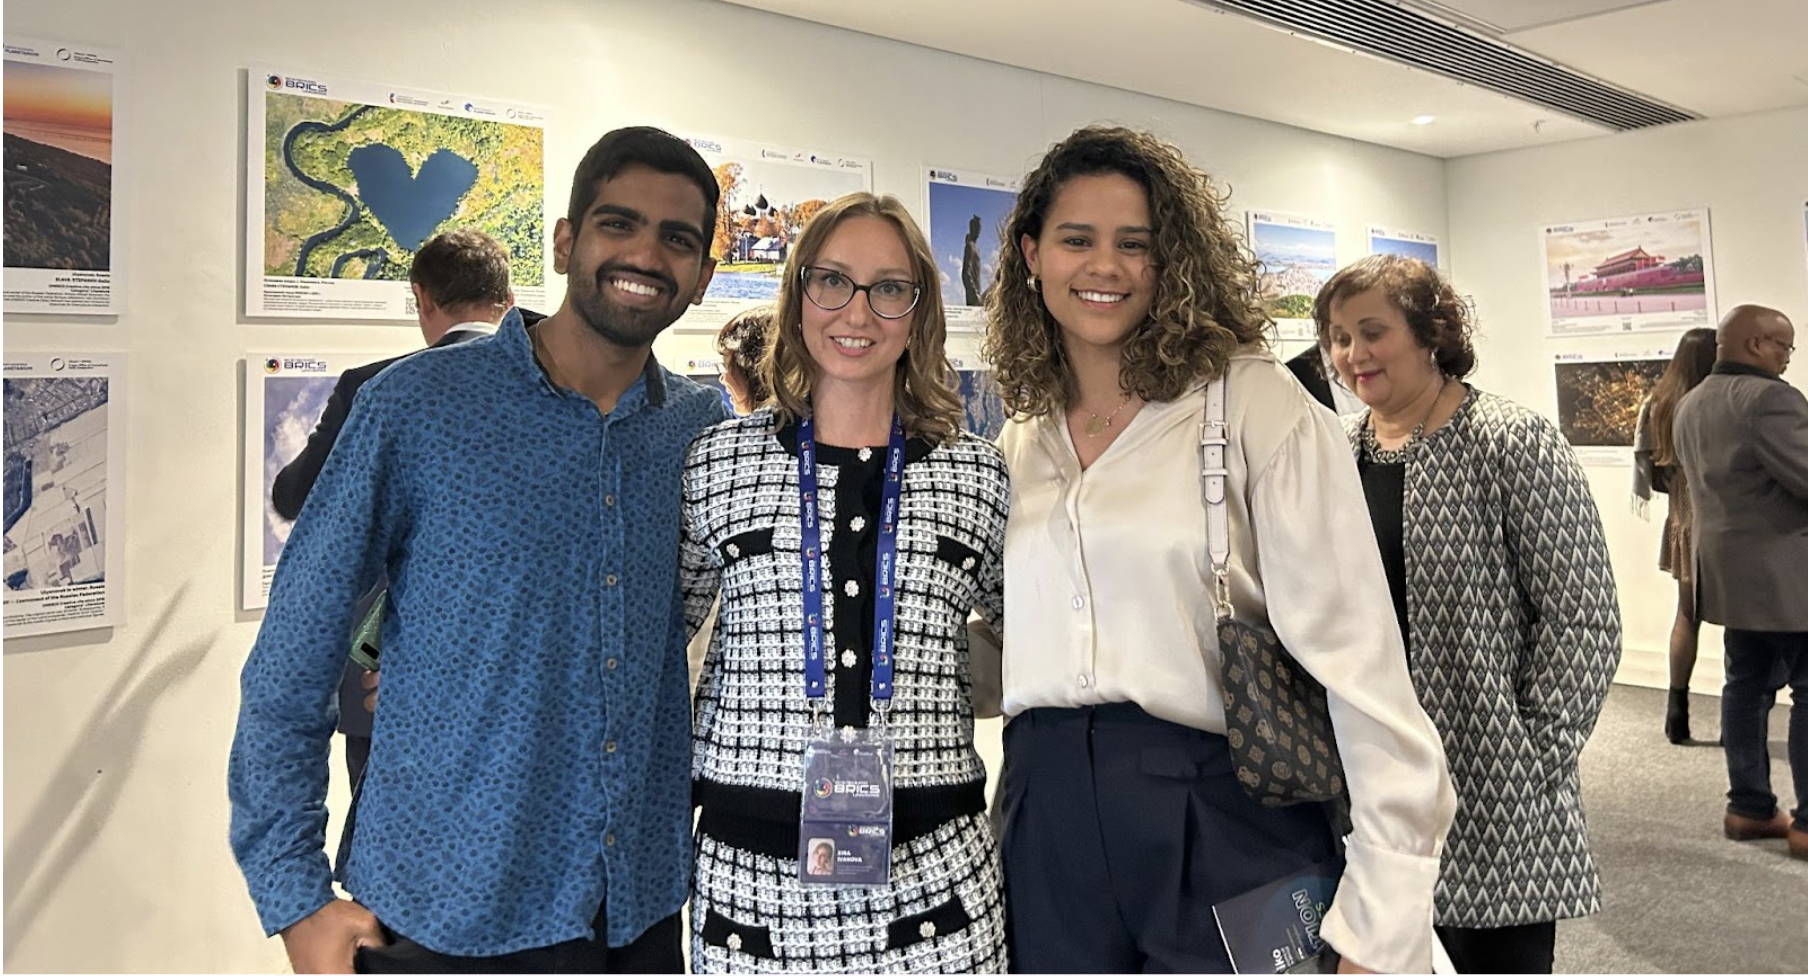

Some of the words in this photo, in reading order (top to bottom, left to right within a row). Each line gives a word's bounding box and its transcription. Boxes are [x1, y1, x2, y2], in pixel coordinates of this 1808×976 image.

[285, 80, 328, 92] BRICS
[283, 361, 327, 370] BRICS
[834, 784, 880, 794] BRICS
